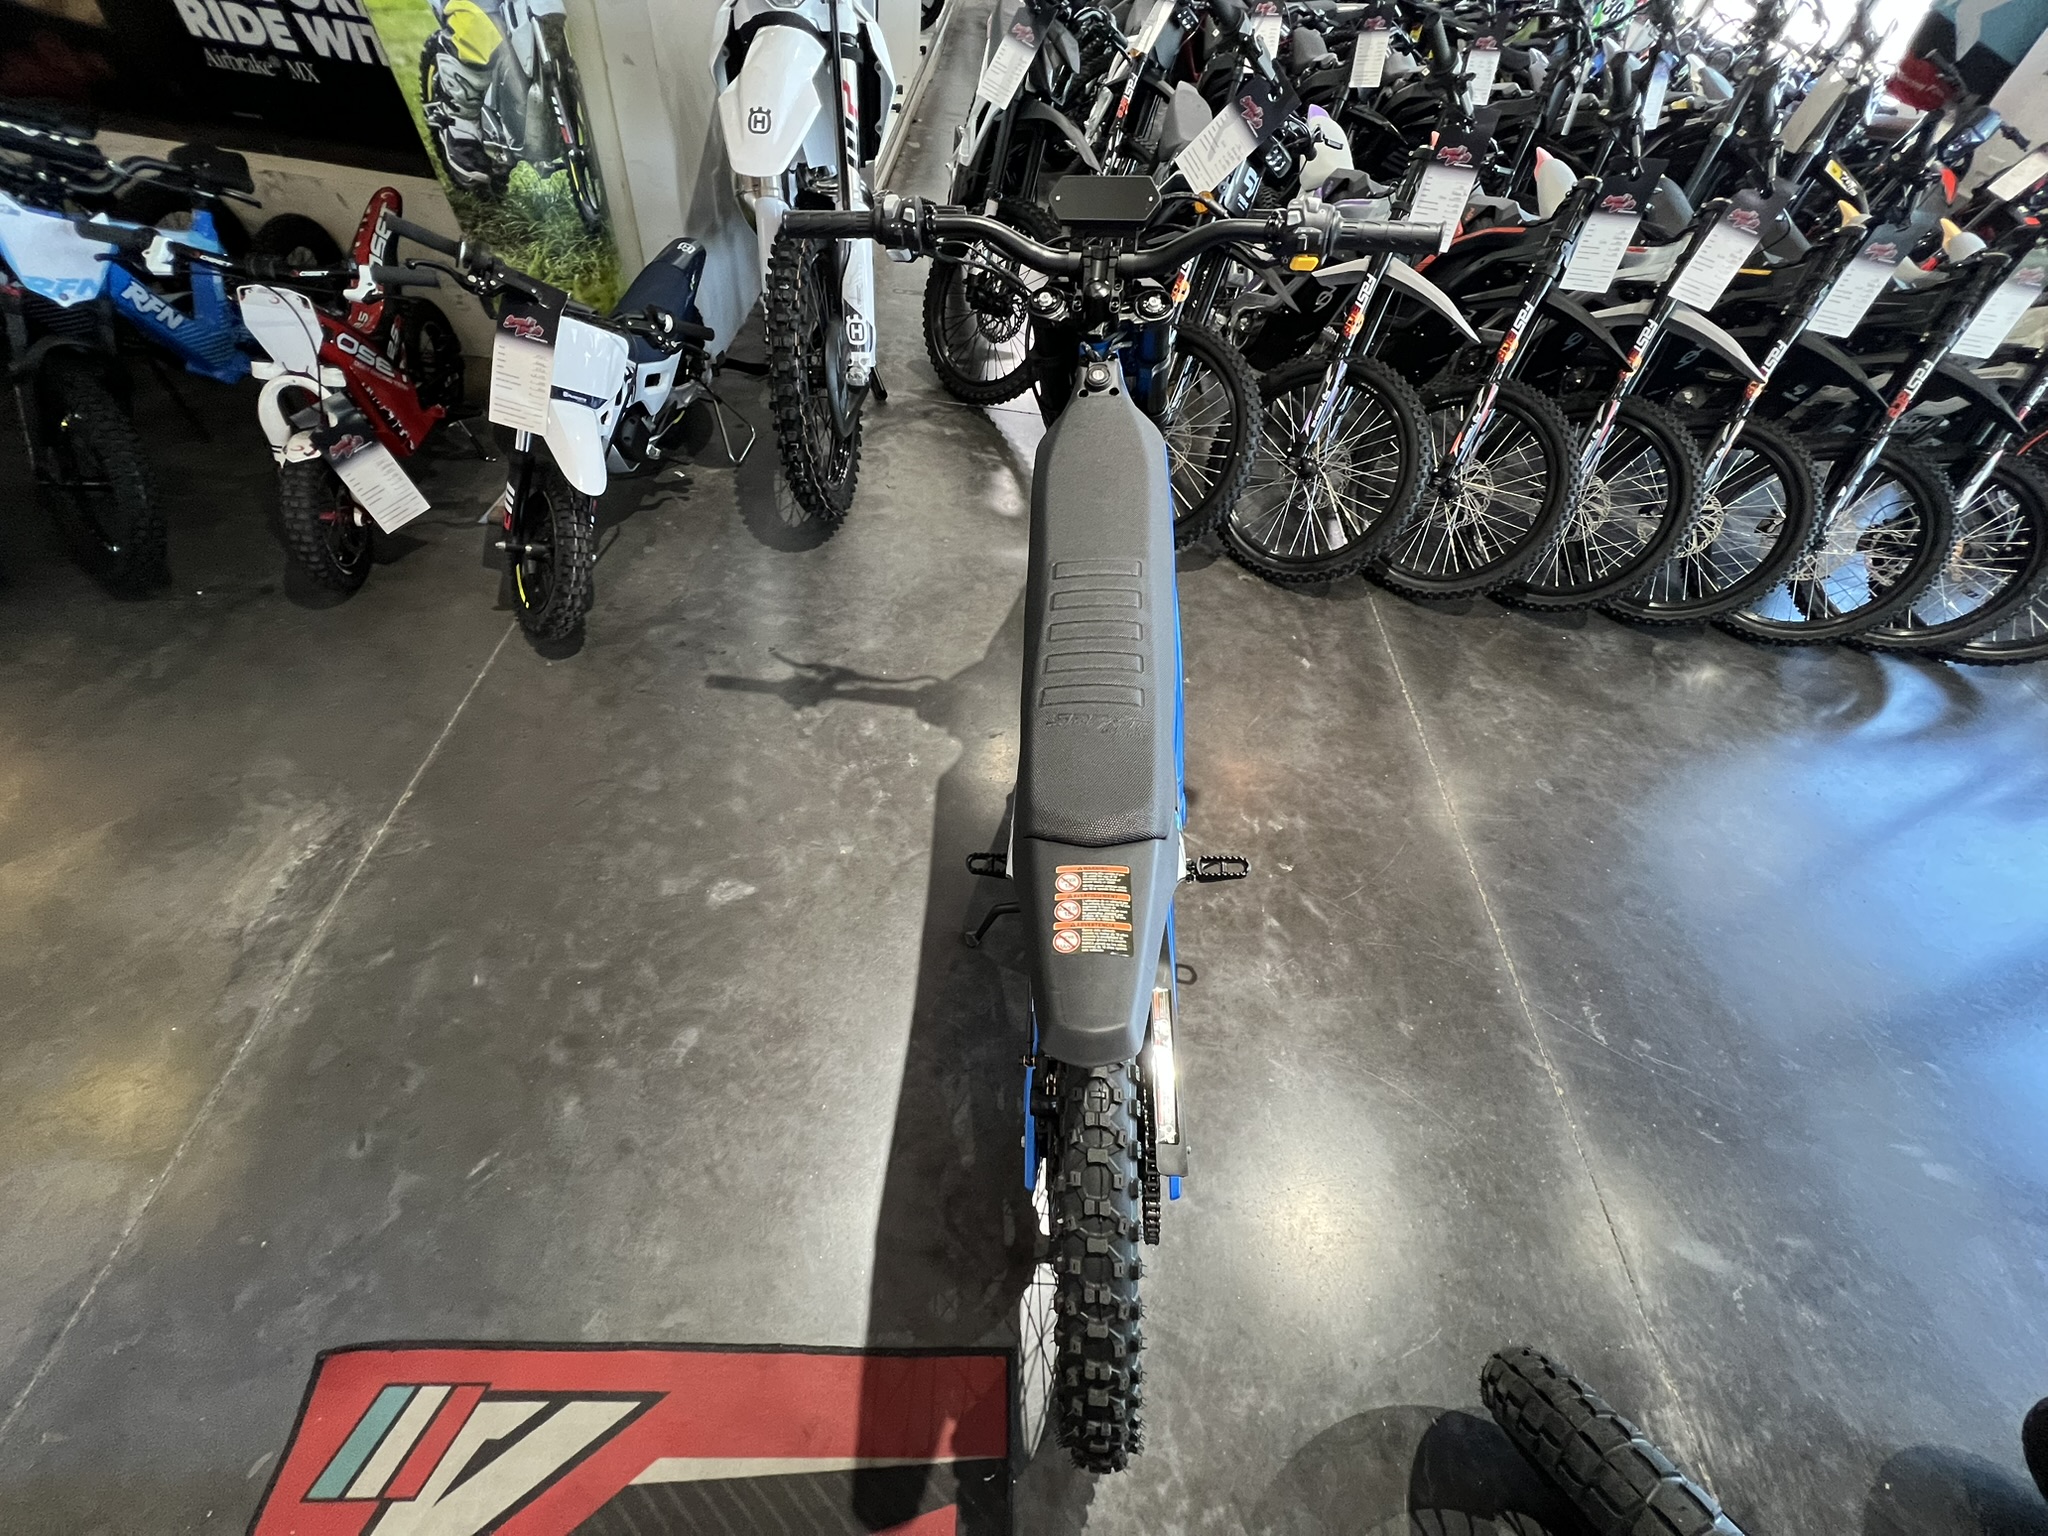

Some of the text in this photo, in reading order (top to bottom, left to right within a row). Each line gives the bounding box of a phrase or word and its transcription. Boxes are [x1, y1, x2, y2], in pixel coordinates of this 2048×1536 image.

[174, 0, 300, 52] RIDE
[285, 59, 320, 83] MX
[120, 281, 185, 330] RFN
